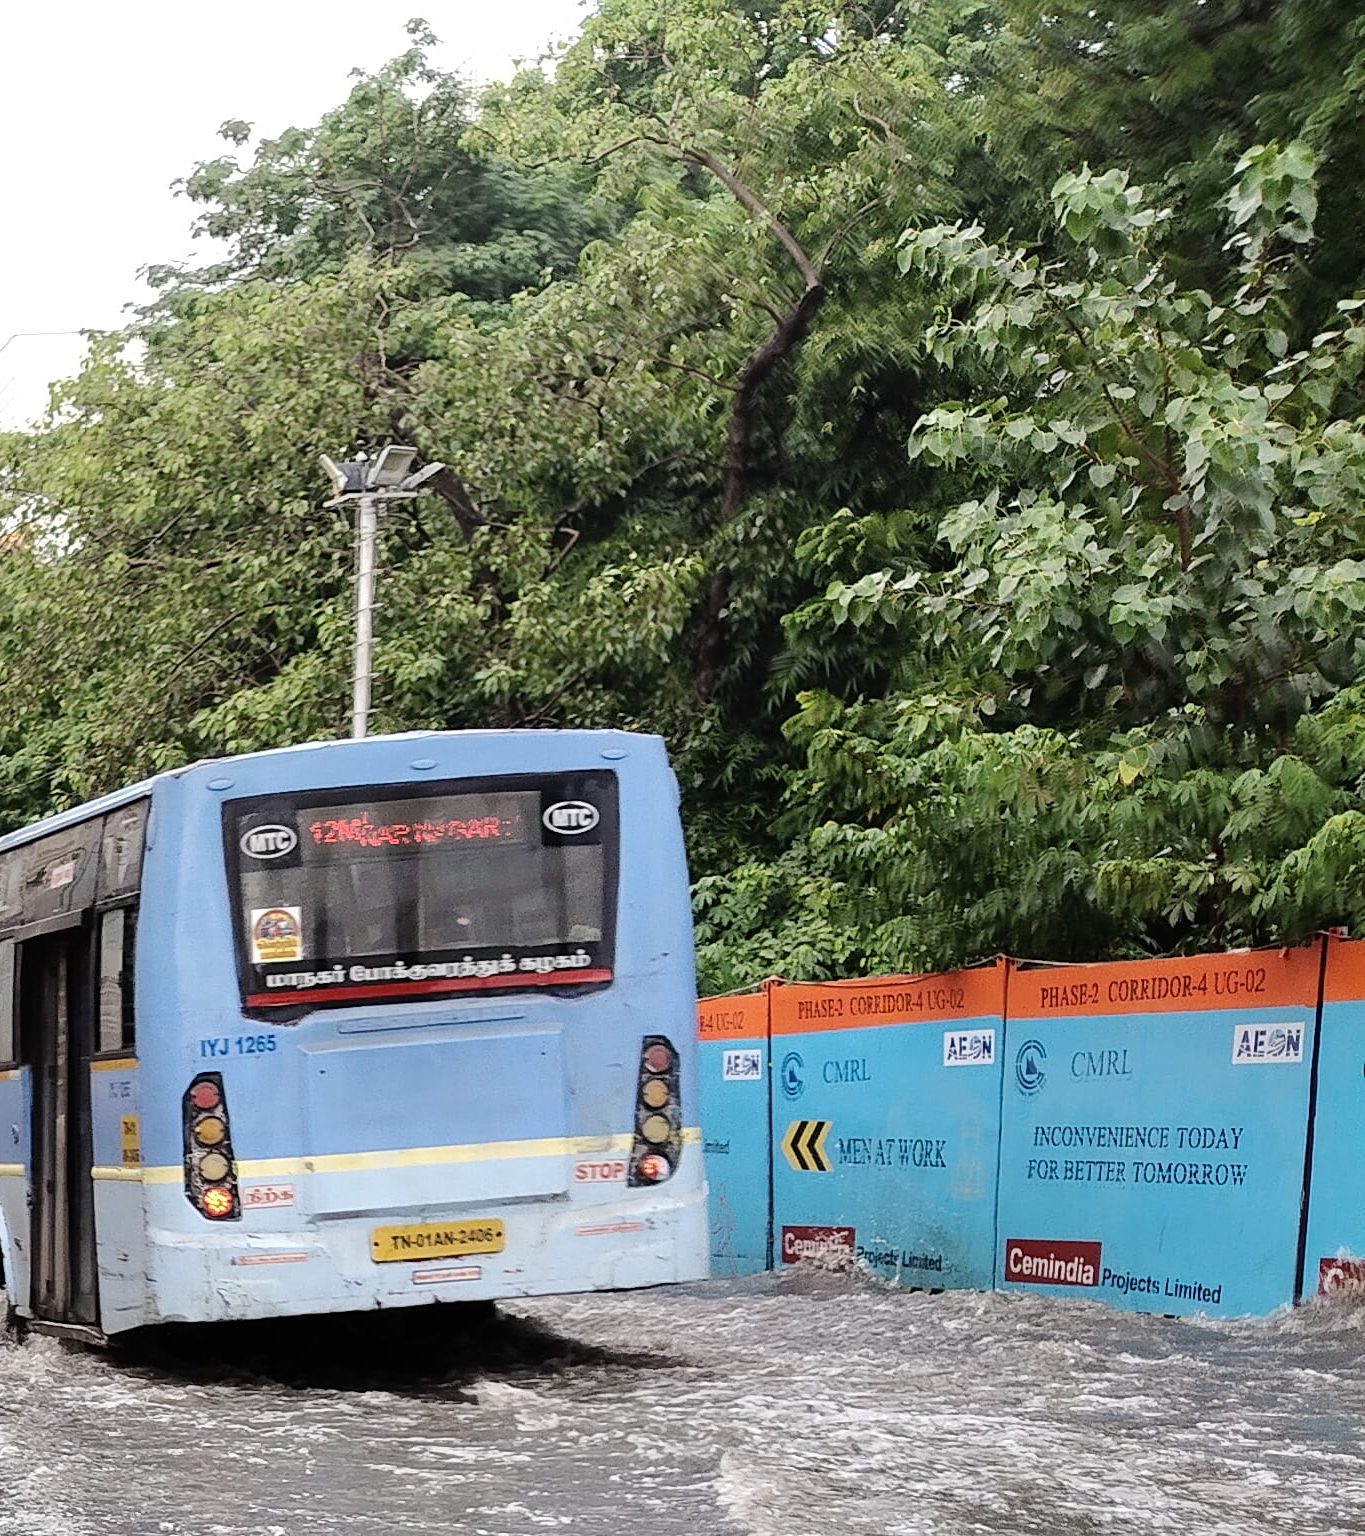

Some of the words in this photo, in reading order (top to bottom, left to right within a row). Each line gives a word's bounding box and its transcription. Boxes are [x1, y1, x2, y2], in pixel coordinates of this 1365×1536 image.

[551, 807, 594, 827] MTC
[249, 831, 291, 852] MTC
[1040, 983, 1099, 1008] PHASE-2
[1108, 972, 1208, 1002] CORRIDOR-4
[1214, 967, 1267, 995] UG-02
[798, 998, 843, 1020] PHASE-2
[849, 989, 923, 1015] CORRIDOR-4
[927, 988, 965, 1010] UG-02
[200, 1038, 229, 1057] IYJ
[235, 1034, 277, 1055] 1265
[947, 1034, 992, 1061] AEON
[1237, 1028, 1301, 1058] AEON
[725, 1054, 760, 1077] AEON
[823, 1058, 871, 1084] CMRL
[1071, 1049, 1132, 1079] CMRL
[1033, 1126, 1170, 1149] INCONVENIENCE
[1177, 1127, 1244, 1149] TODAY
[838, 1137, 870, 1165] MEN
[876, 1139, 895, 1165] AT
[897, 1139, 947, 1168] WORK
[574, 1162, 625, 1181] STOP
[1027, 1159, 1060, 1180] FOR
[1063, 1160, 1126, 1182] BETTER
[1132, 1161, 1249, 1187] TOMORROW
[902, 1250, 943, 1272] Limited
[1009, 1247, 1095, 1285] Cemindia
[1102, 1267, 1160, 1295] Projects
[1164, 1278, 1222, 1305] Limited
